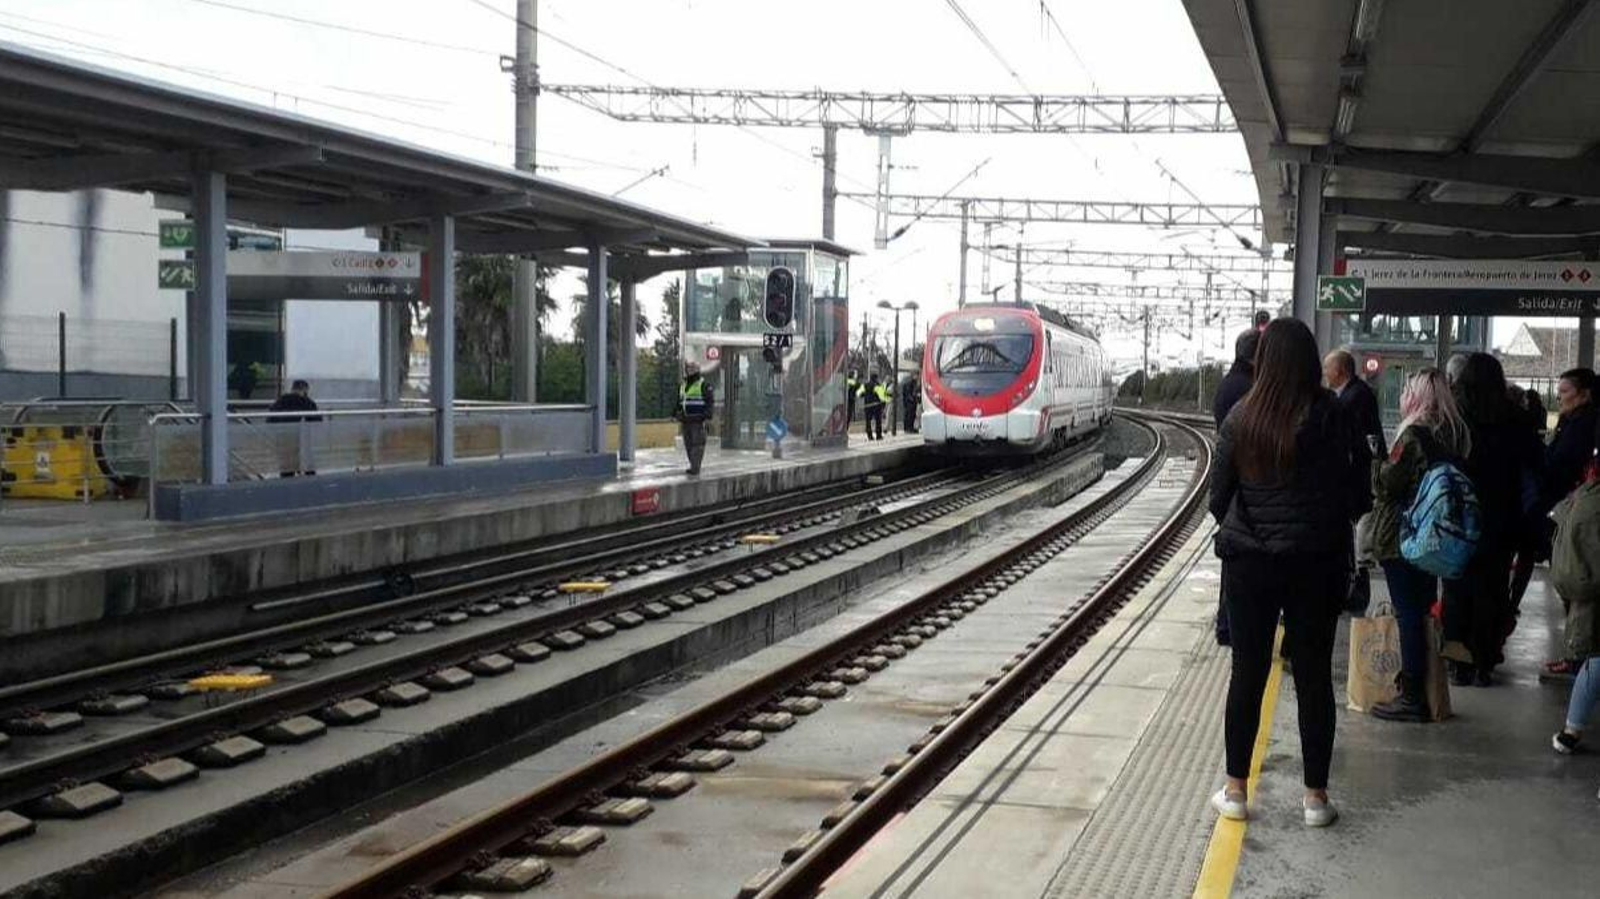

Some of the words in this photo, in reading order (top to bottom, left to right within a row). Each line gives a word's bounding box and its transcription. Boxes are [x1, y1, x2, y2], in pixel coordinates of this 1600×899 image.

[1371, 268, 1394, 281] Jerez
[1397, 269, 1408, 279] de
[1411, 268, 1420, 279] la
[1519, 270, 1531, 280] de
[1533, 270, 1557, 281] Jerez
[1518, 297, 1583, 311] Salida/Exit
